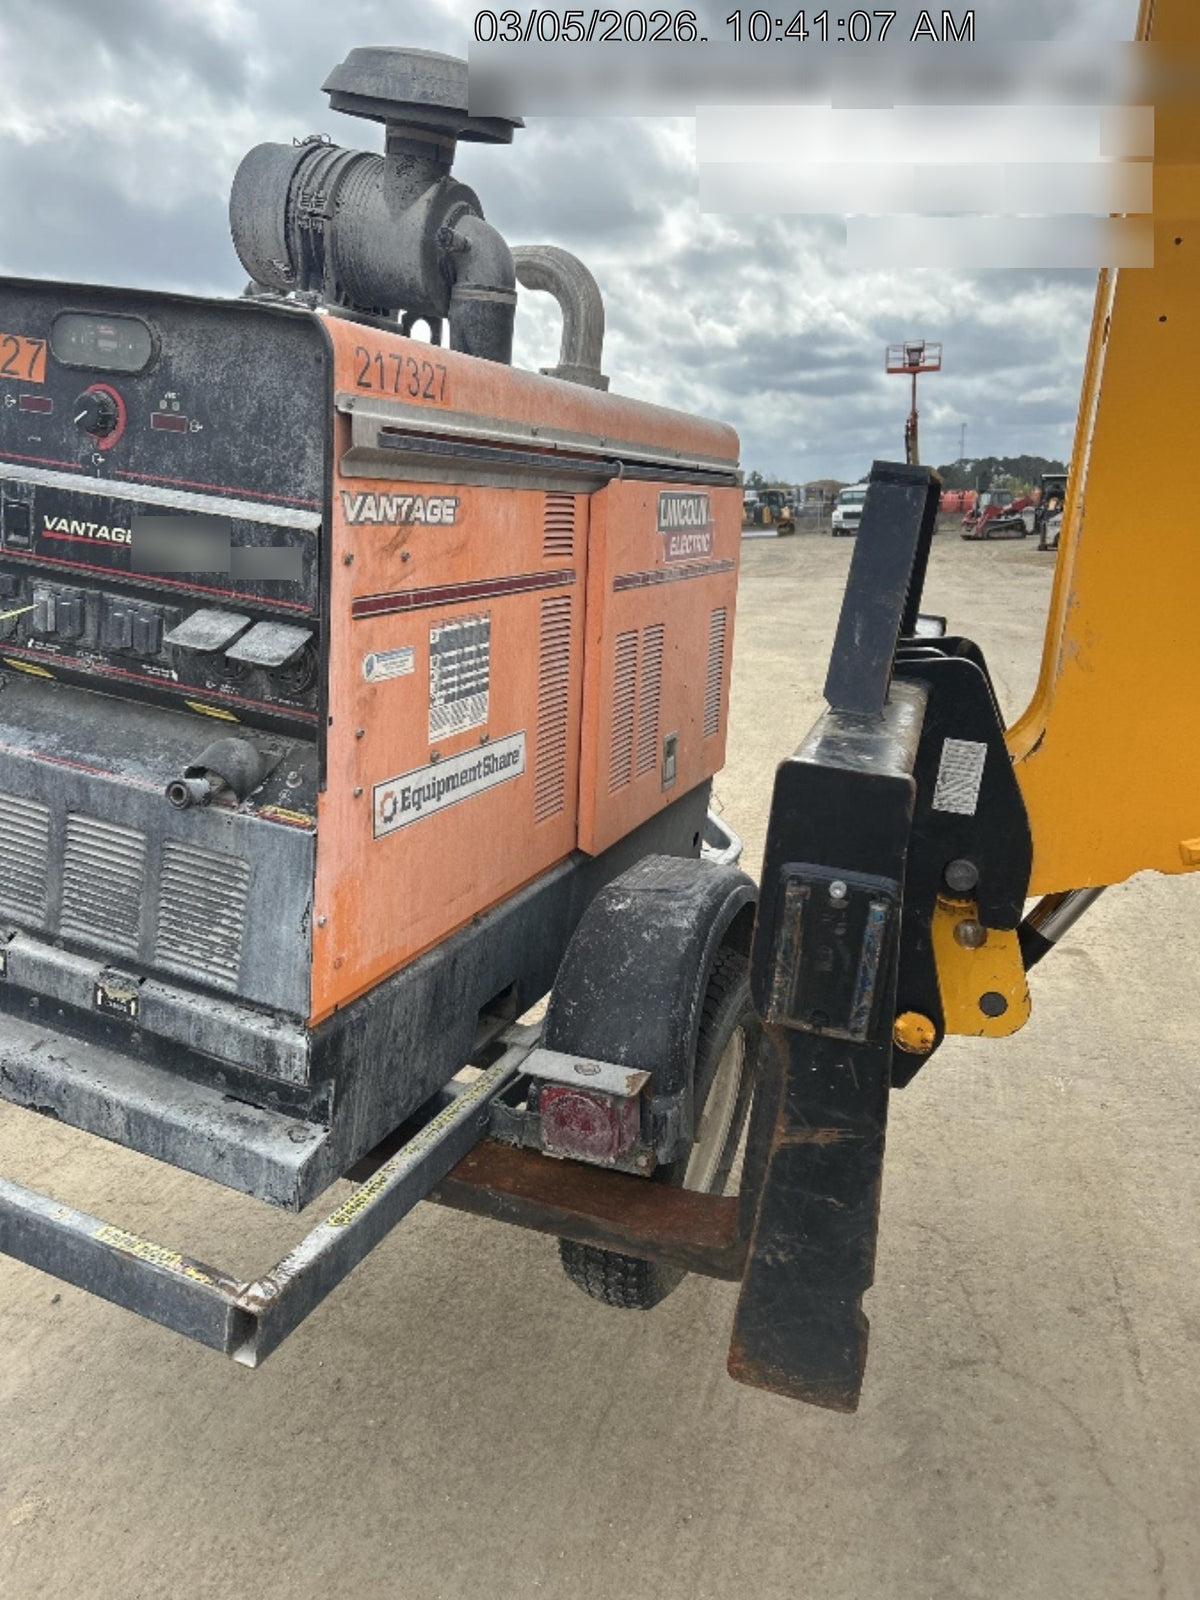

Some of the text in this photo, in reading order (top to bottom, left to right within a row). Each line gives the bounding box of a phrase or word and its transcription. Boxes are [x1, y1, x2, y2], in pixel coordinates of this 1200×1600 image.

[1, 336, 44, 378] 27
[356, 346, 447, 401] 217327
[340, 491, 458, 525] VANTAGE
[660, 498, 708, 528] LINCOLN
[401, 752, 520, 811] EquipmentShare
